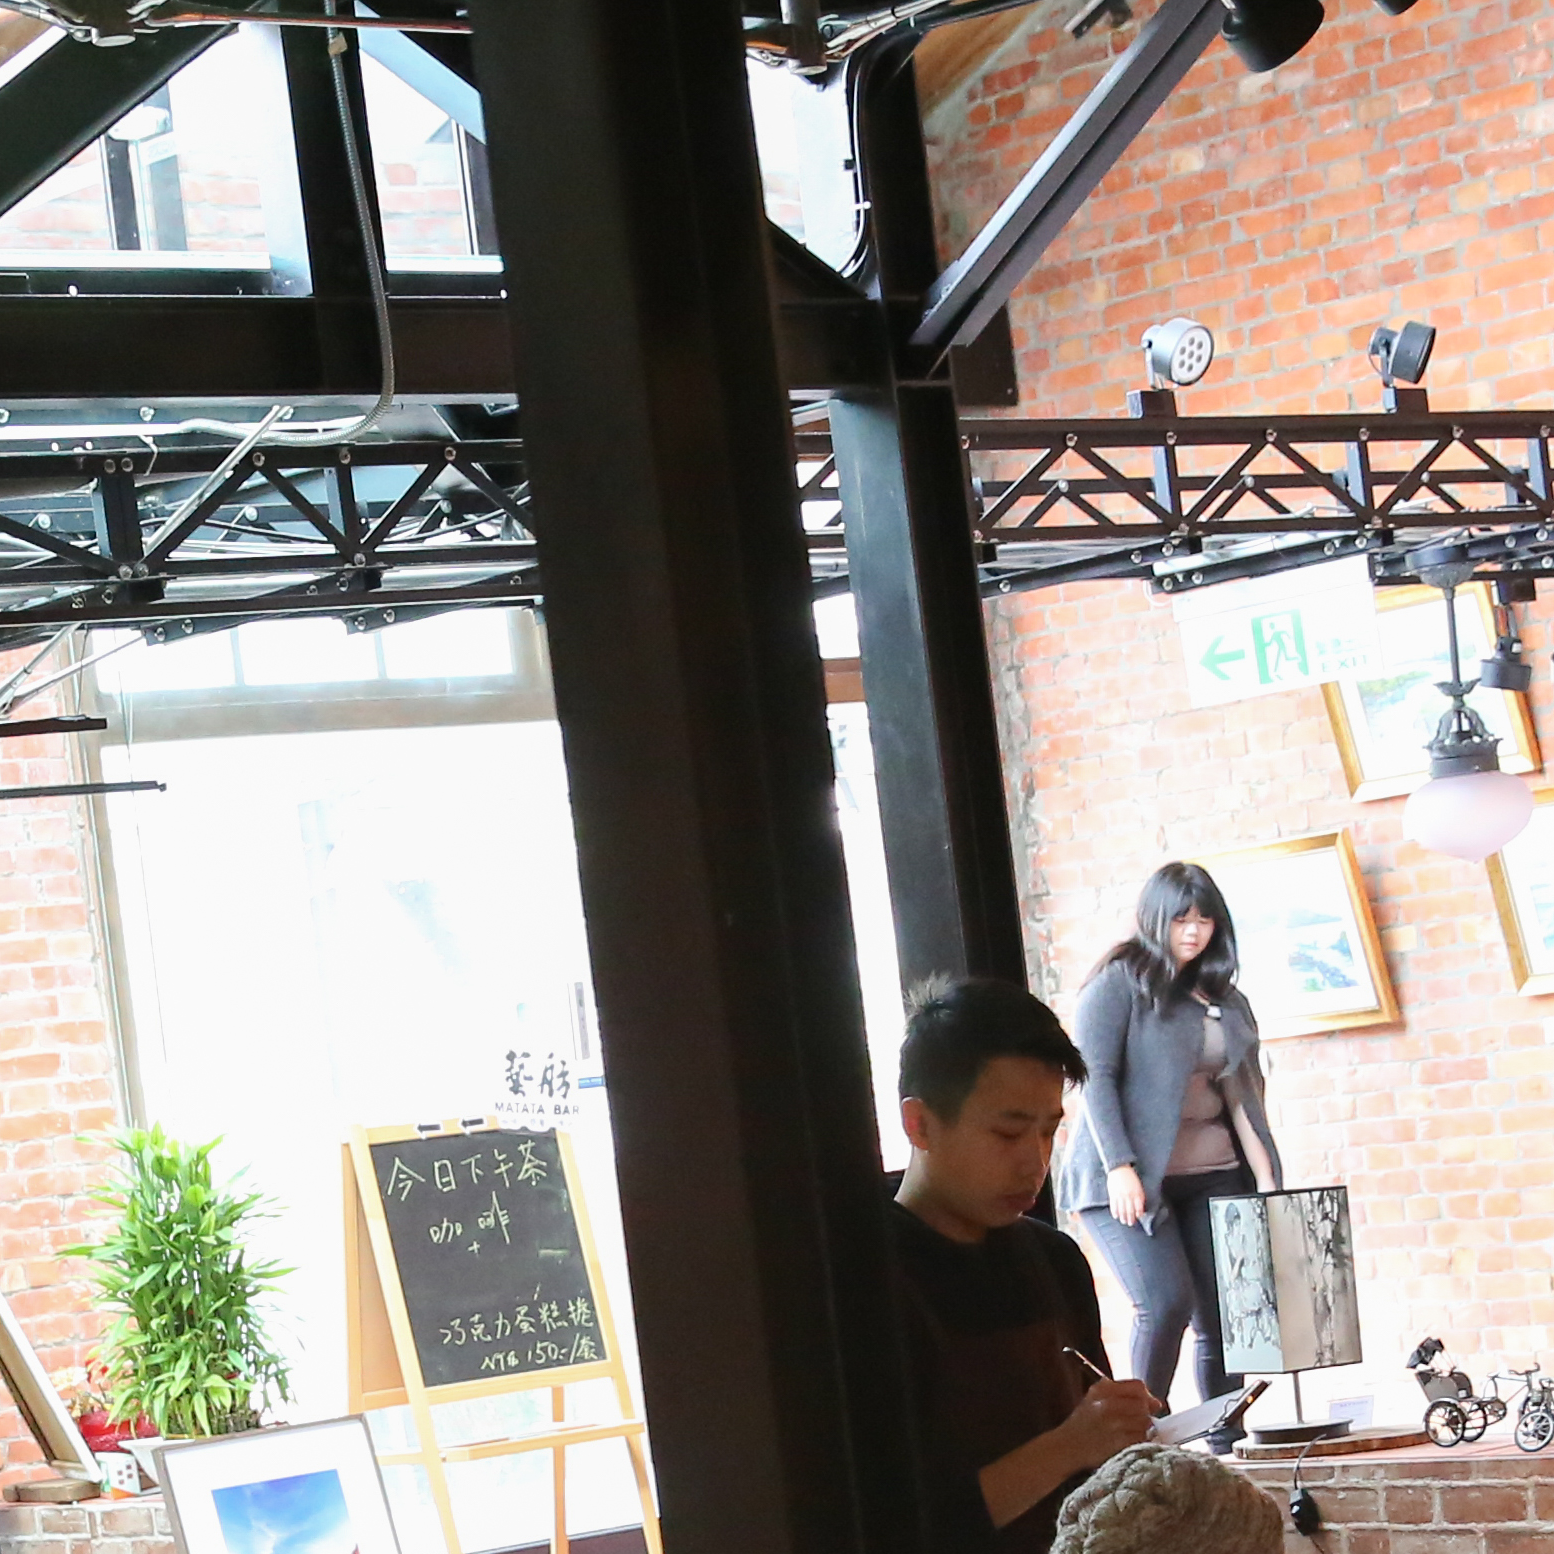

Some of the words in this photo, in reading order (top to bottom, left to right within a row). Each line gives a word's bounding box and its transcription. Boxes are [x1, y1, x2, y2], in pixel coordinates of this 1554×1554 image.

[1321, 654, 1368, 673] EXIT
[495, 1101, 545, 1115] MATATA
[553, 1104, 580, 1116] BAR
[386, 1139, 548, 1202] 今日下午茶
[428, 1190, 512, 1245] 咖啡
